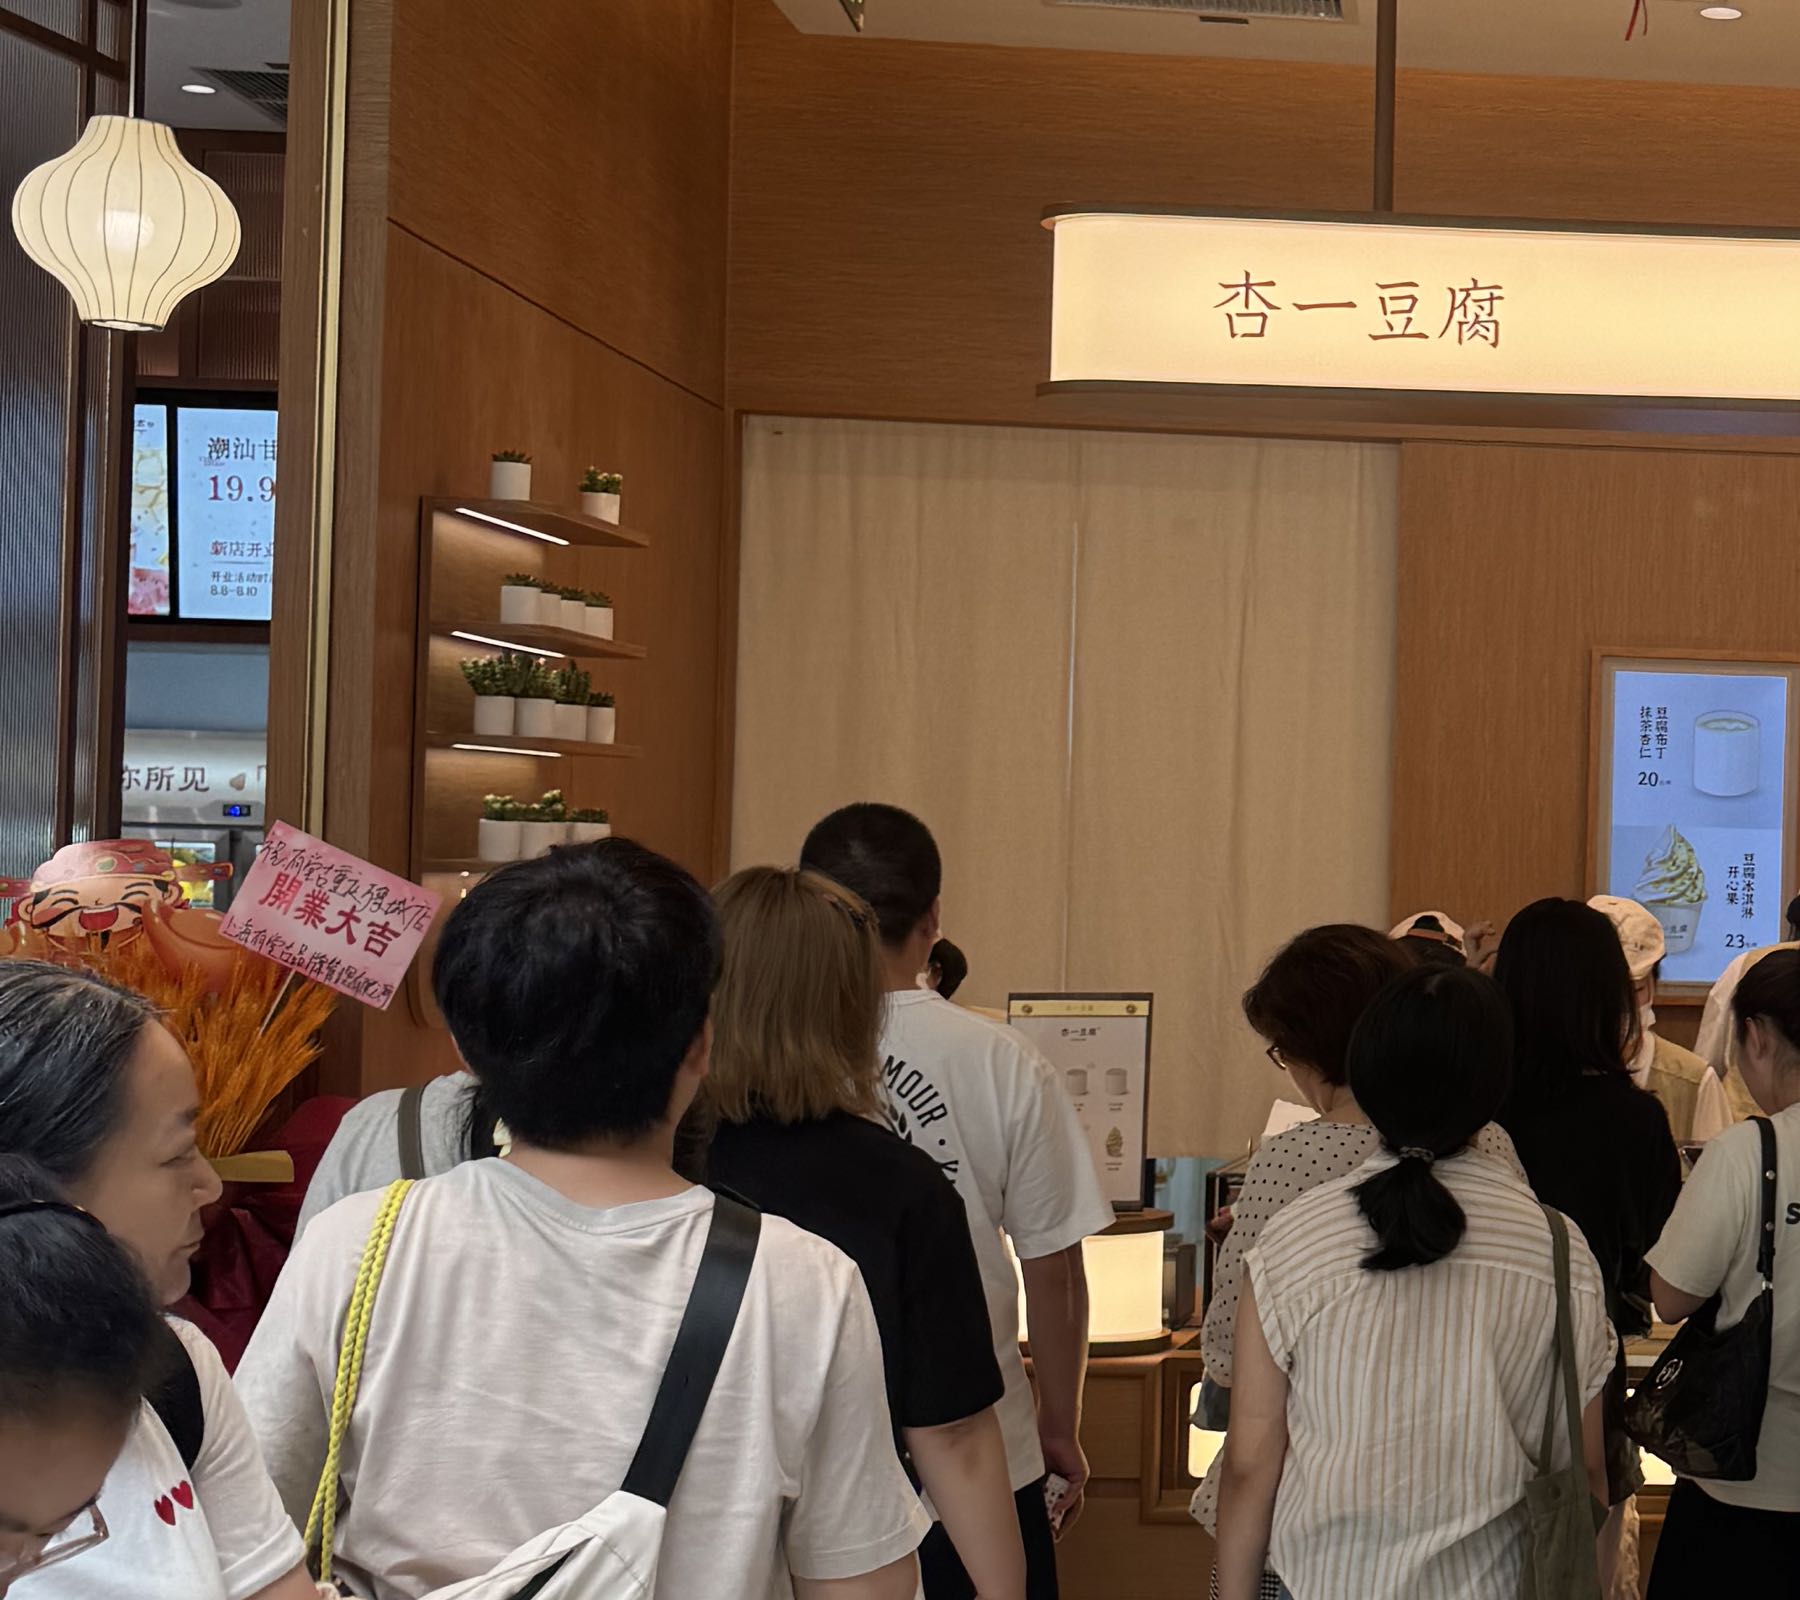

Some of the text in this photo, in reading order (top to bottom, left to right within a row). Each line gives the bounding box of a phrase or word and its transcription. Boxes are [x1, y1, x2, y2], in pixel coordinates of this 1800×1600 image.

[1213, 269, 1505, 349] 杏一豆腐
[1638, 771, 1659, 787] 20
[1726, 866, 1739, 905] 开心果
[1725, 933, 1745, 949] 23
